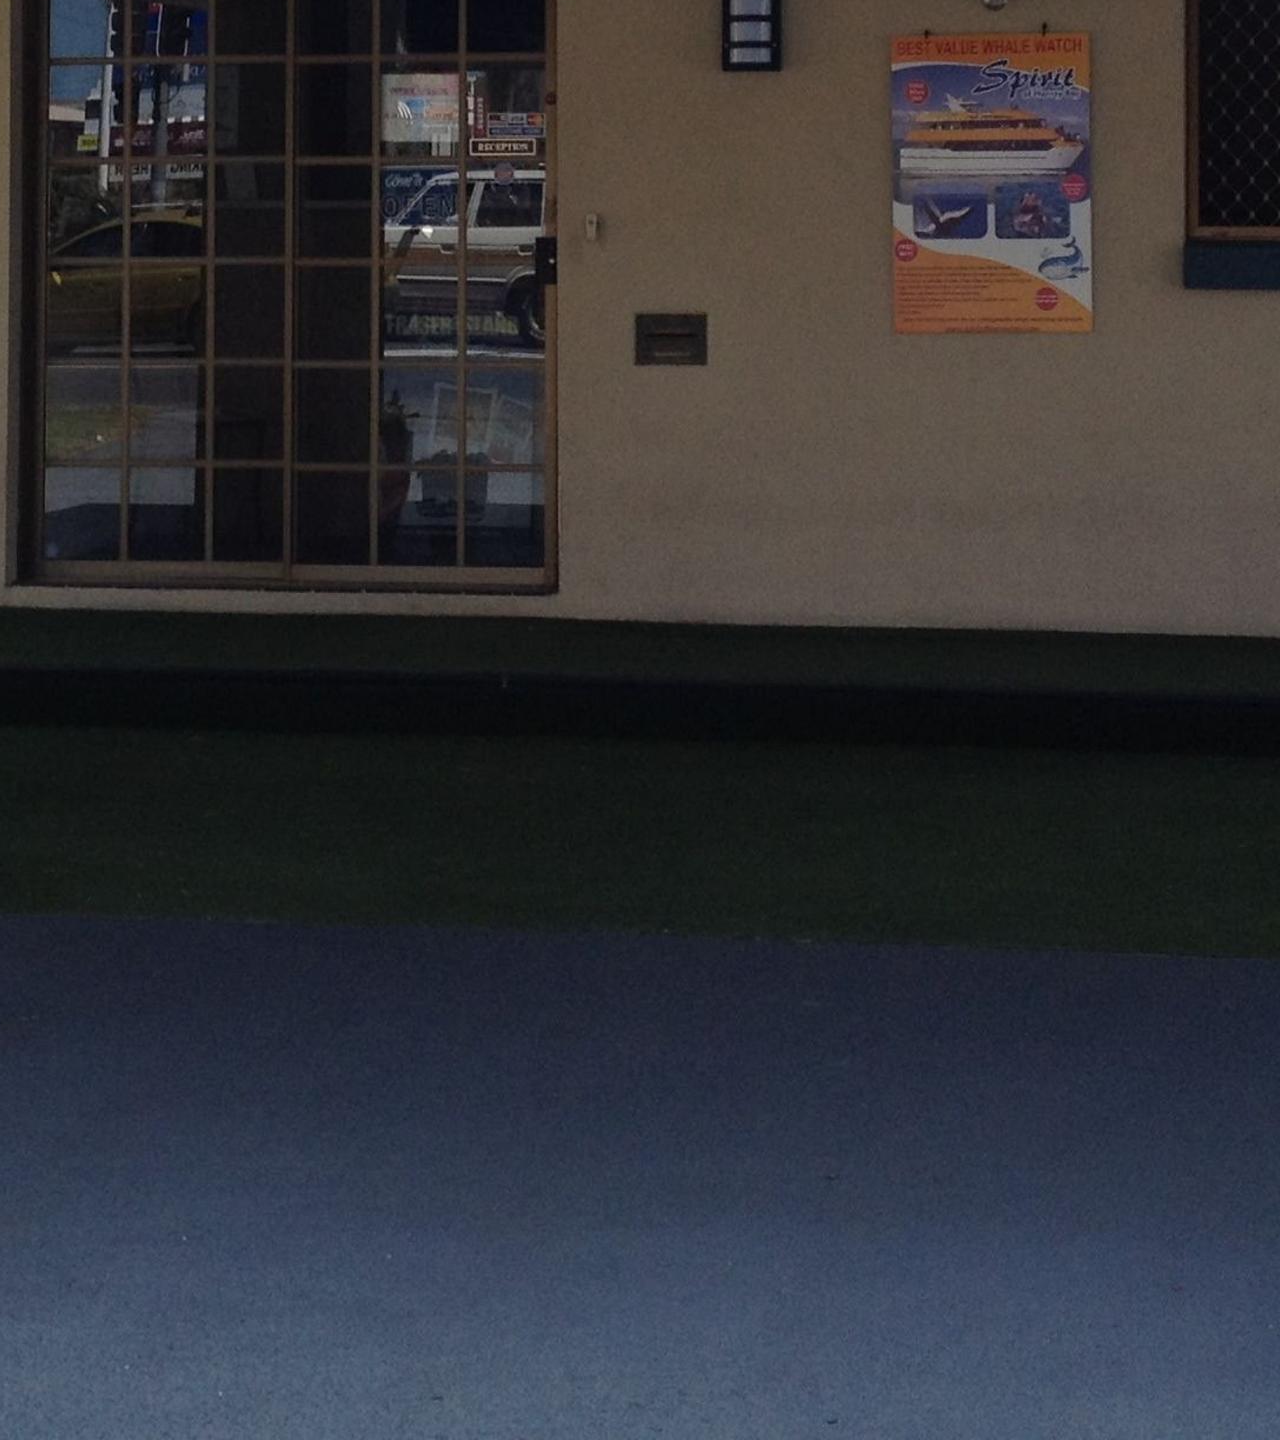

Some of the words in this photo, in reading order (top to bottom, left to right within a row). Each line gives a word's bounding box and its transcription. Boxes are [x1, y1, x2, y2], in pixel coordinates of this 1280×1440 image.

[897, 41, 931, 56] BEST
[936, 40, 978, 56] VALUE
[981, 39, 1031, 55] WHALE
[1035, 38, 1083, 54] WATCH
[972, 58, 1076, 98] Spirit
[477, 143, 529, 152] RECEPTION
[463, 315, 520, 336] SLAND
